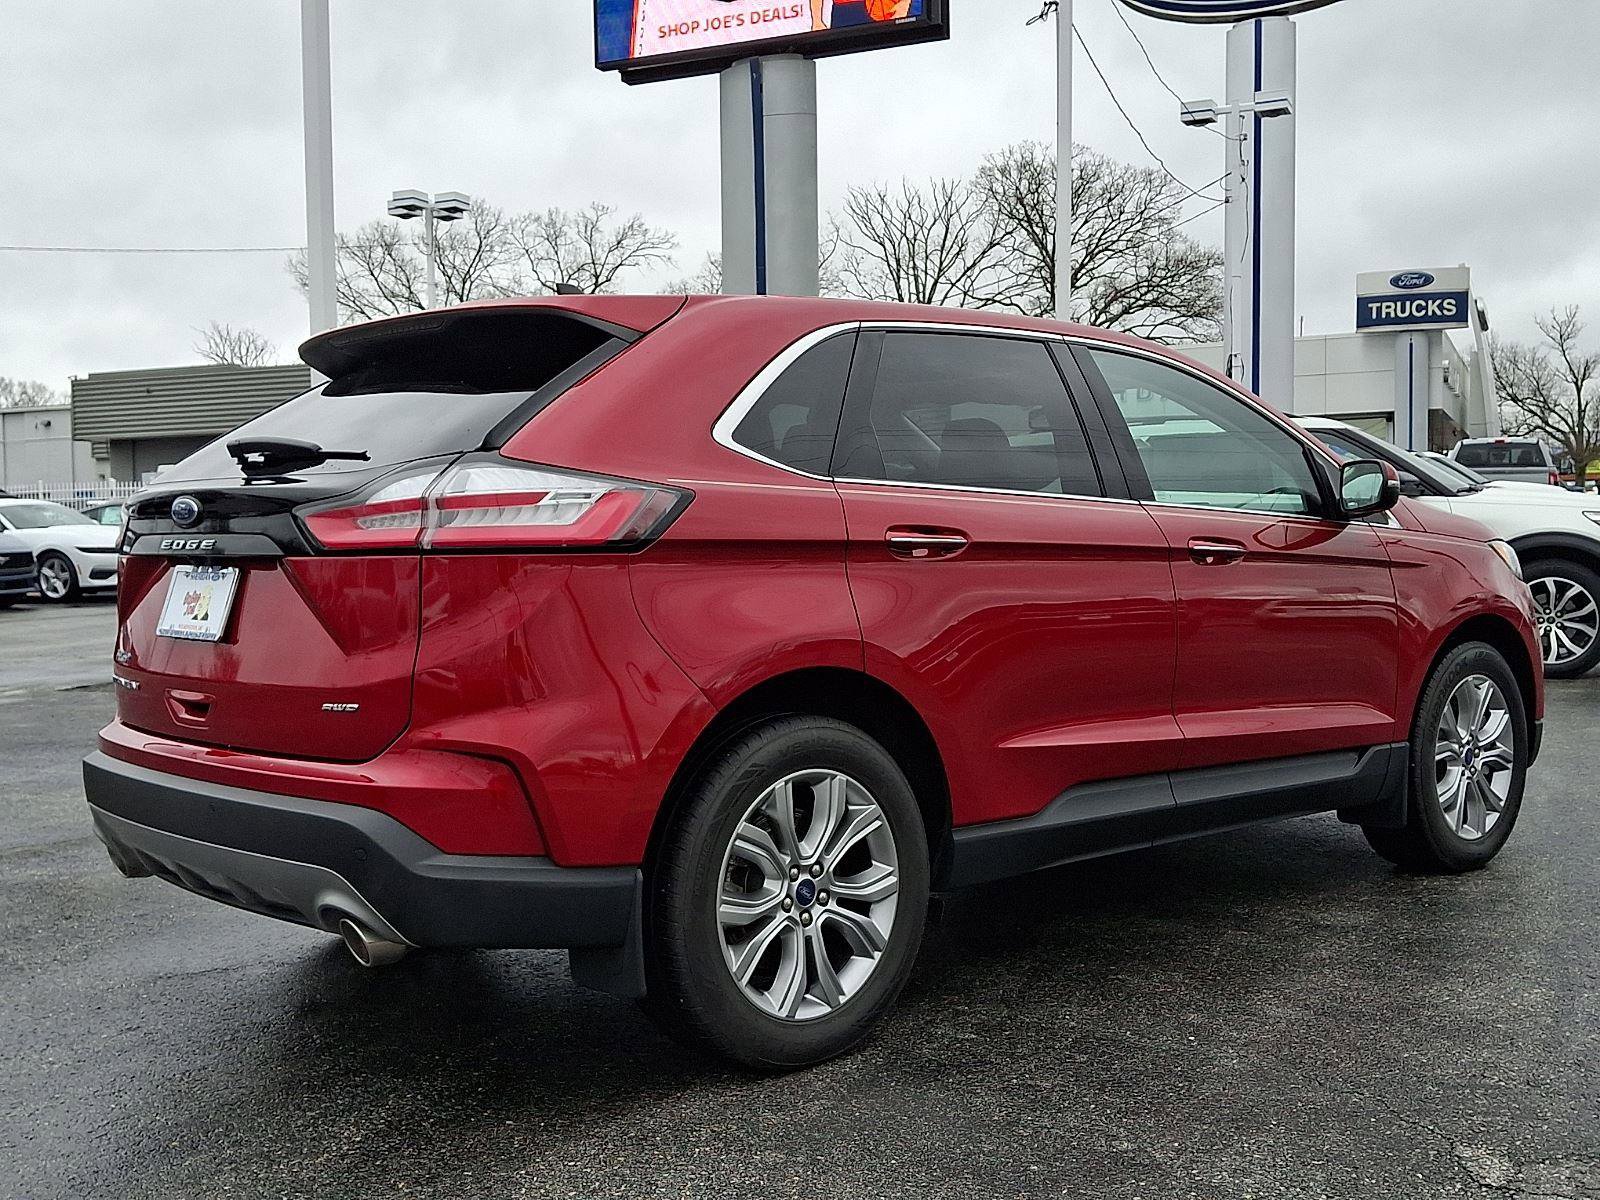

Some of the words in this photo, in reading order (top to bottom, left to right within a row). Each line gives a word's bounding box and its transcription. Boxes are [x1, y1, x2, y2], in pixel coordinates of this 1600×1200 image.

[658, 20, 700, 38] SHOP
[703, 13, 745, 32] JOE'S
[750, 4, 804, 25] DEALS!
[1398, 273, 1426, 286] Ford
[1368, 298, 1457, 320] TRUCKS
[160, 539, 216, 550] EDGE
